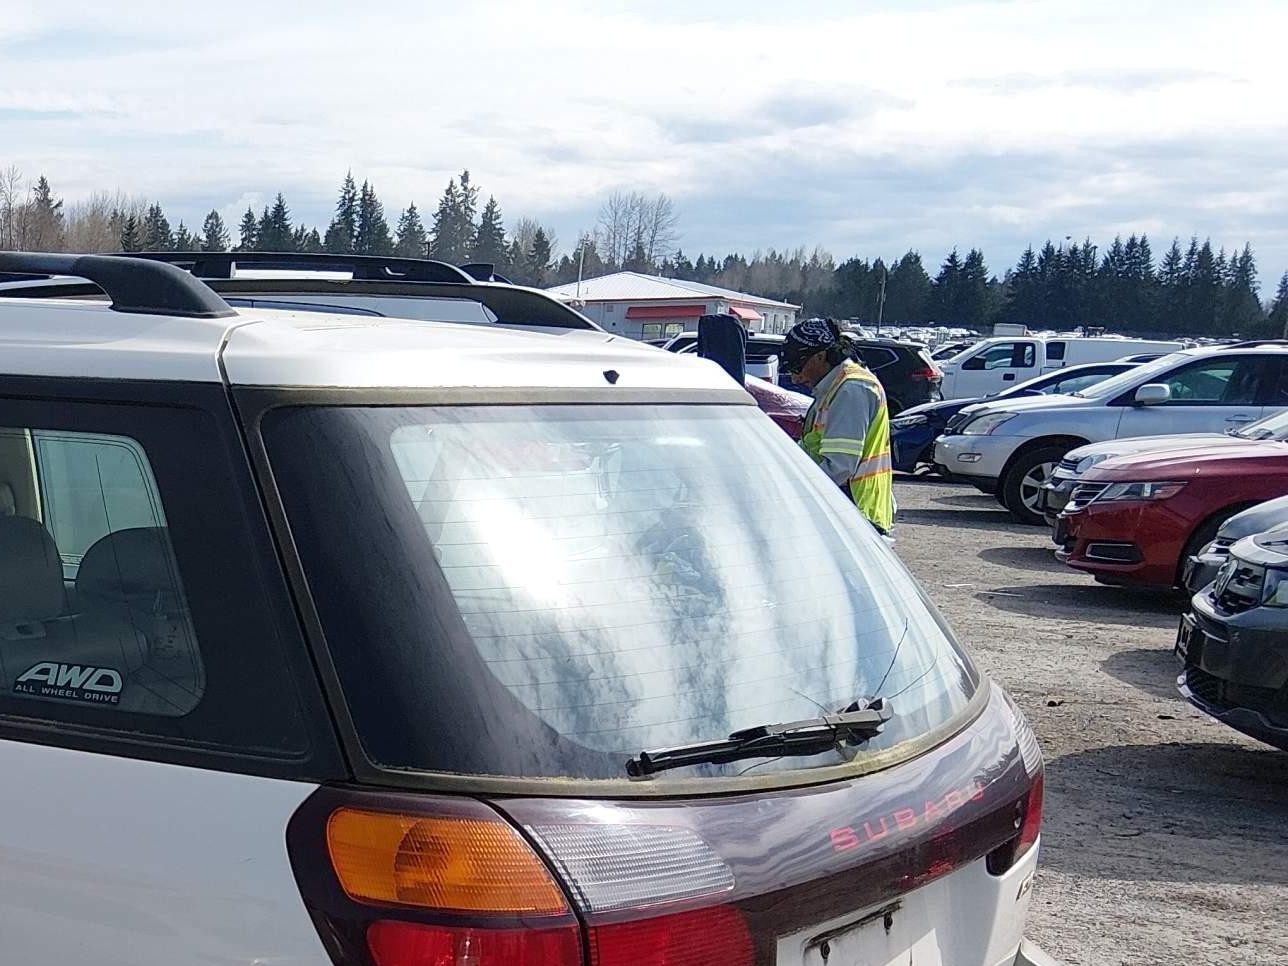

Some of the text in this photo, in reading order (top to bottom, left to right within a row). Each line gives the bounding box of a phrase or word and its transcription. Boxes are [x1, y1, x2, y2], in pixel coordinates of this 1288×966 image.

[15, 662, 123, 693] AWD
[15, 684, 119, 703] ALL WHEEL DRIVE
[829, 781, 985, 851] SUBARU
